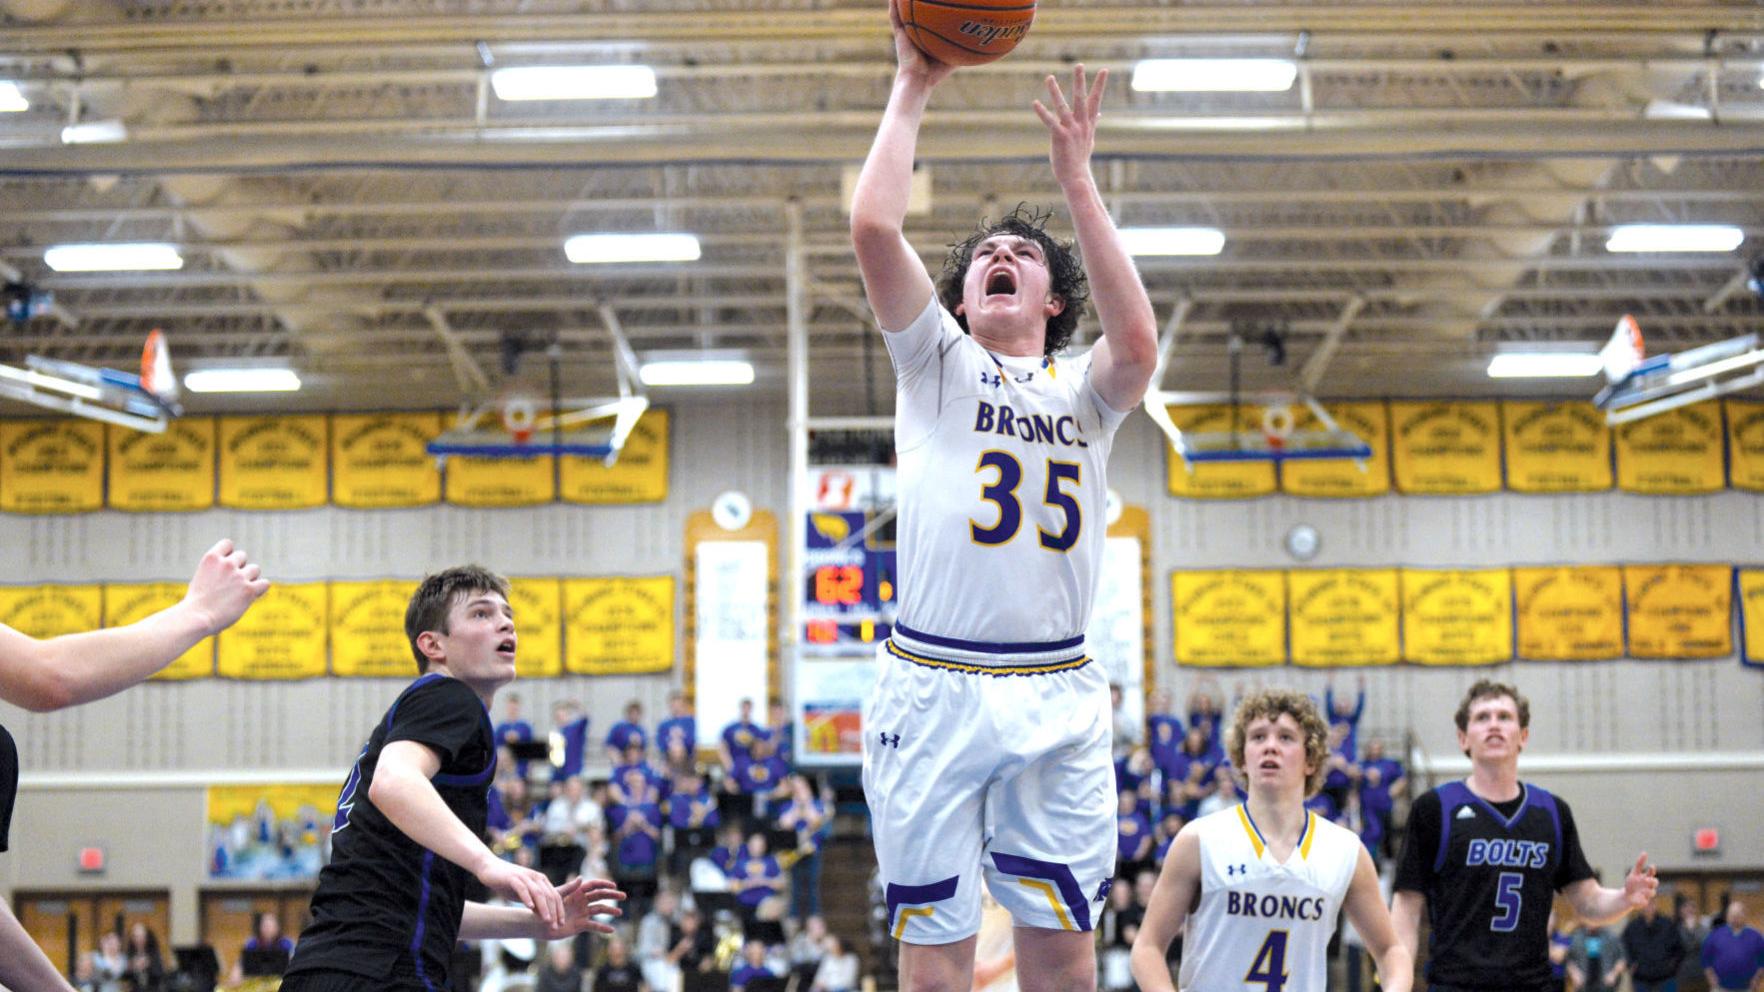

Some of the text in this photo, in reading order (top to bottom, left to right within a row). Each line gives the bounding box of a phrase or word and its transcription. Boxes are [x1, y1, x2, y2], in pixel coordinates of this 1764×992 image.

[969, 449, 1083, 555] 35
[815, 564, 864, 606] 62
[1466, 838, 1549, 868] BOLTS
[1226, 890, 1325, 921] BRONCS
[1490, 872, 1522, 932] 5
[1244, 928, 1291, 992] 4
